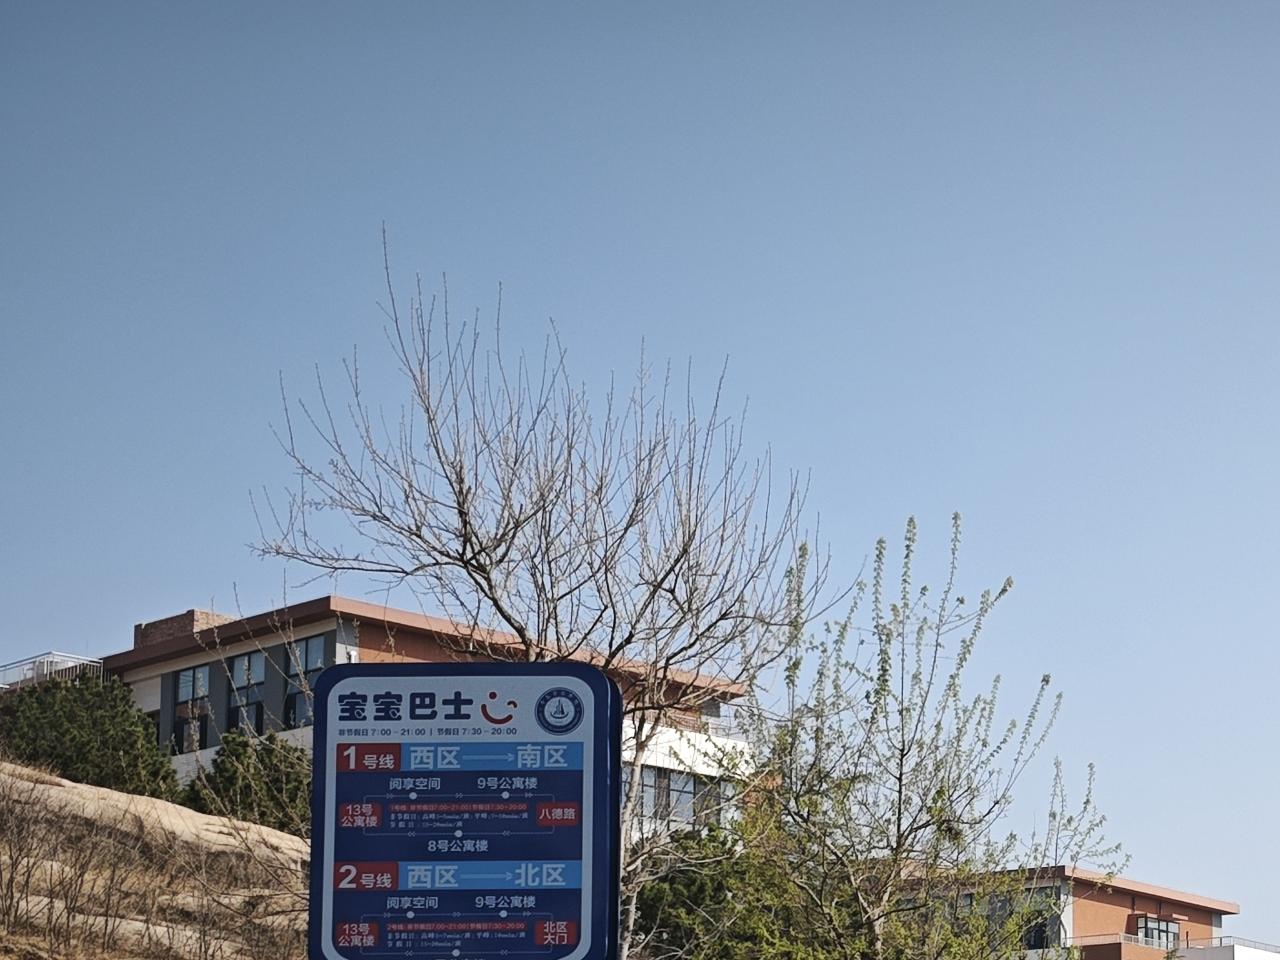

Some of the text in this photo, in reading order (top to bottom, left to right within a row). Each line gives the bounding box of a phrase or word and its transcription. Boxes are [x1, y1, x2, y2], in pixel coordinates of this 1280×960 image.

[338, 691, 474, 722] 宝宝巴士
[401, 728, 426, 736] 21:00
[491, 727, 517, 735] 20:00
[342, 744, 568, 769] 1号线 西区 南区
[477, 777, 538, 789] 9号公寓楼
[346, 804, 373, 815] 13号
[539, 808, 576, 819] 八德路
[342, 815, 378, 827] 公寓楼
[428, 840, 489, 852] 8号公寓楼
[338, 864, 566, 889] 2号线 西区 北区
[475, 896, 536, 908] 9号公寓楼
[343, 923, 371, 935] 13号
[544, 922, 568, 933] 北区
[338, 935, 376, 947] 公寓楼
[544, 933, 567, 945] 大门
